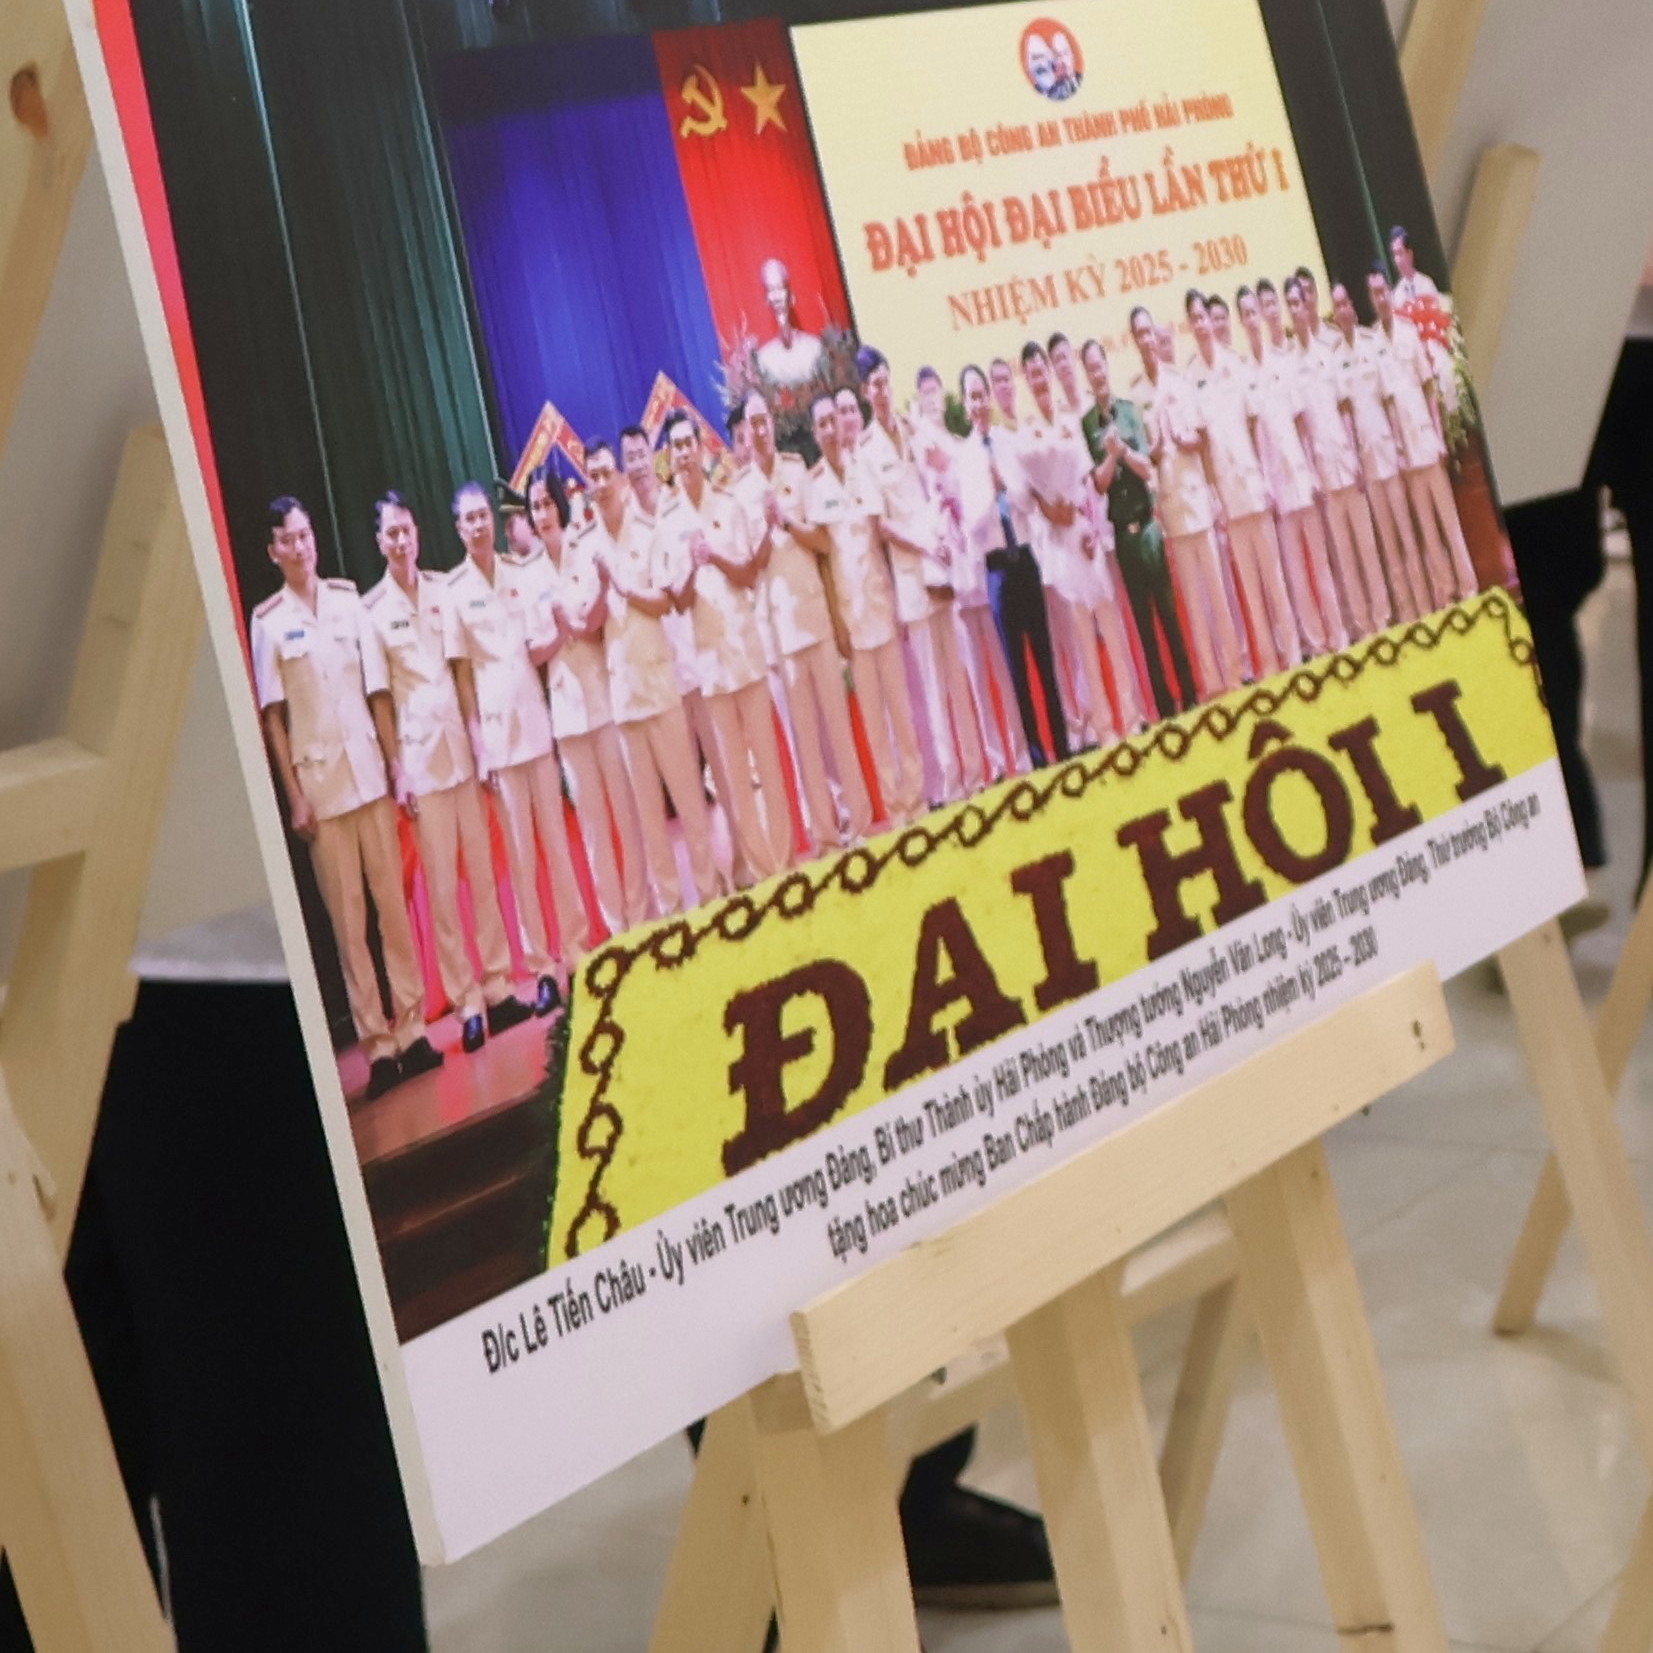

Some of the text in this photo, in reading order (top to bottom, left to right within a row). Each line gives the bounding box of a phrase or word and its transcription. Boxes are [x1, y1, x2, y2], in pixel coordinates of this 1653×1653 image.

[1038, 120, 1061, 147] AN
[863, 213, 935, 278] ĐẠI
[936, 190, 1003, 263] HỘI
[1003, 189, 1067, 249] ĐẠI
[1067, 155, 1143, 230] BIỂU
[1144, 144, 1207, 215] LẦN
[1208, 141, 1269, 203] THỨ
[947, 274, 1060, 331] NHIỆM
[1064, 253, 1106, 303] KỲ
[1115, 249, 1174, 293] 2025
[1193, 234, 1248, 276] 2030
[481, 1322, 520, 1374] Đ/c
[519, 1305, 549, 1355] Lê
[547, 1277, 595, 1337] Tiến
[594, 1259, 647, 1314] Châu
[656, 1229, 686, 1285] Ủy
[686, 1218, 727, 1264] viên
[724, 1190, 781, 1244] Trung
[779, 1168, 829, 1217] ương
[825, 1145, 878, 1191] Đảng,
[874, 1121, 897, 1165] Bí
[895, 1115, 925, 1154] thư
[923, 1084, 976, 1137] Thành
[973, 1075, 995, 1118] ủy
[993, 1056, 1021, 1102] Hải
[1019, 1042, 1070, 1087] Phòng
[1067, 1023, 1088, 1062] và
[1085, 1003, 1144, 1051] Thượng
[827, 1212, 869, 1263] tặng
[864, 1196, 900, 1236] hoa
[900, 1170, 939, 1218] chúc
[938, 1149, 988, 1196] mừng
[983, 1130, 1017, 1172] Ban
[1014, 1099, 1055, 1152] Chấp
[1053, 1084, 1092, 1132] hành
[1088, 1069, 1130, 1112] Đảng
[1125, 1051, 1148, 1094] bộ
[1146, 1040, 1185, 1079] Công
[1183, 1031, 1201, 1061] an
[1220, 996, 1265, 1038] Phòng
